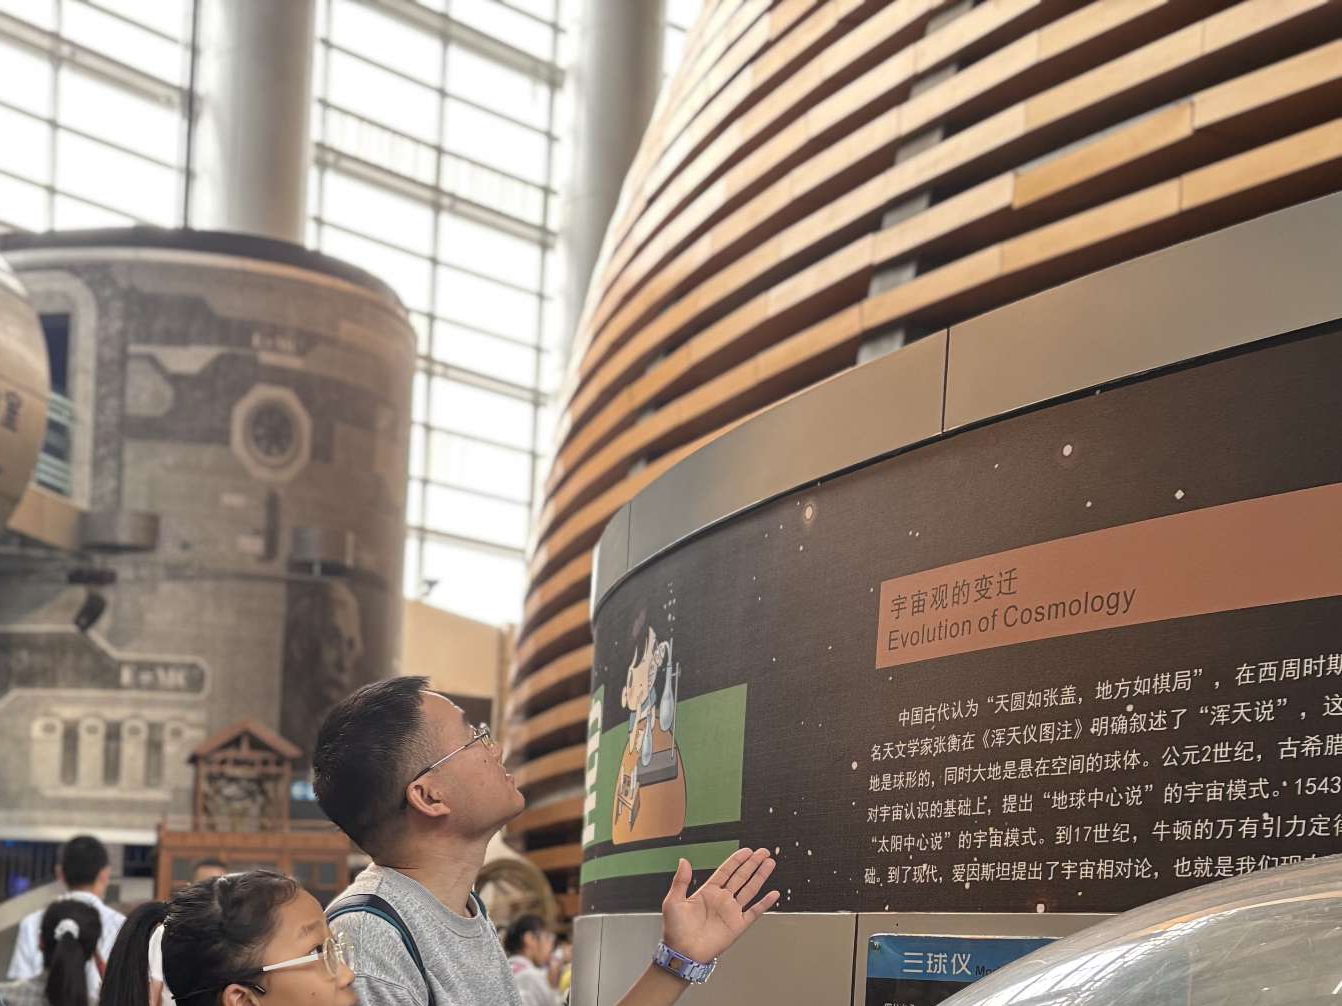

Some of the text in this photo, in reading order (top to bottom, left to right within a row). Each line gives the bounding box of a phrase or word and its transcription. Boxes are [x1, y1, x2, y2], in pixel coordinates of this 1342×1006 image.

[888, 587, 1137, 651] Evolution of Cosmology
[890, 567, 1019, 620] 宇宙观的变迁
[902, 952, 972, 976] 三球仪
